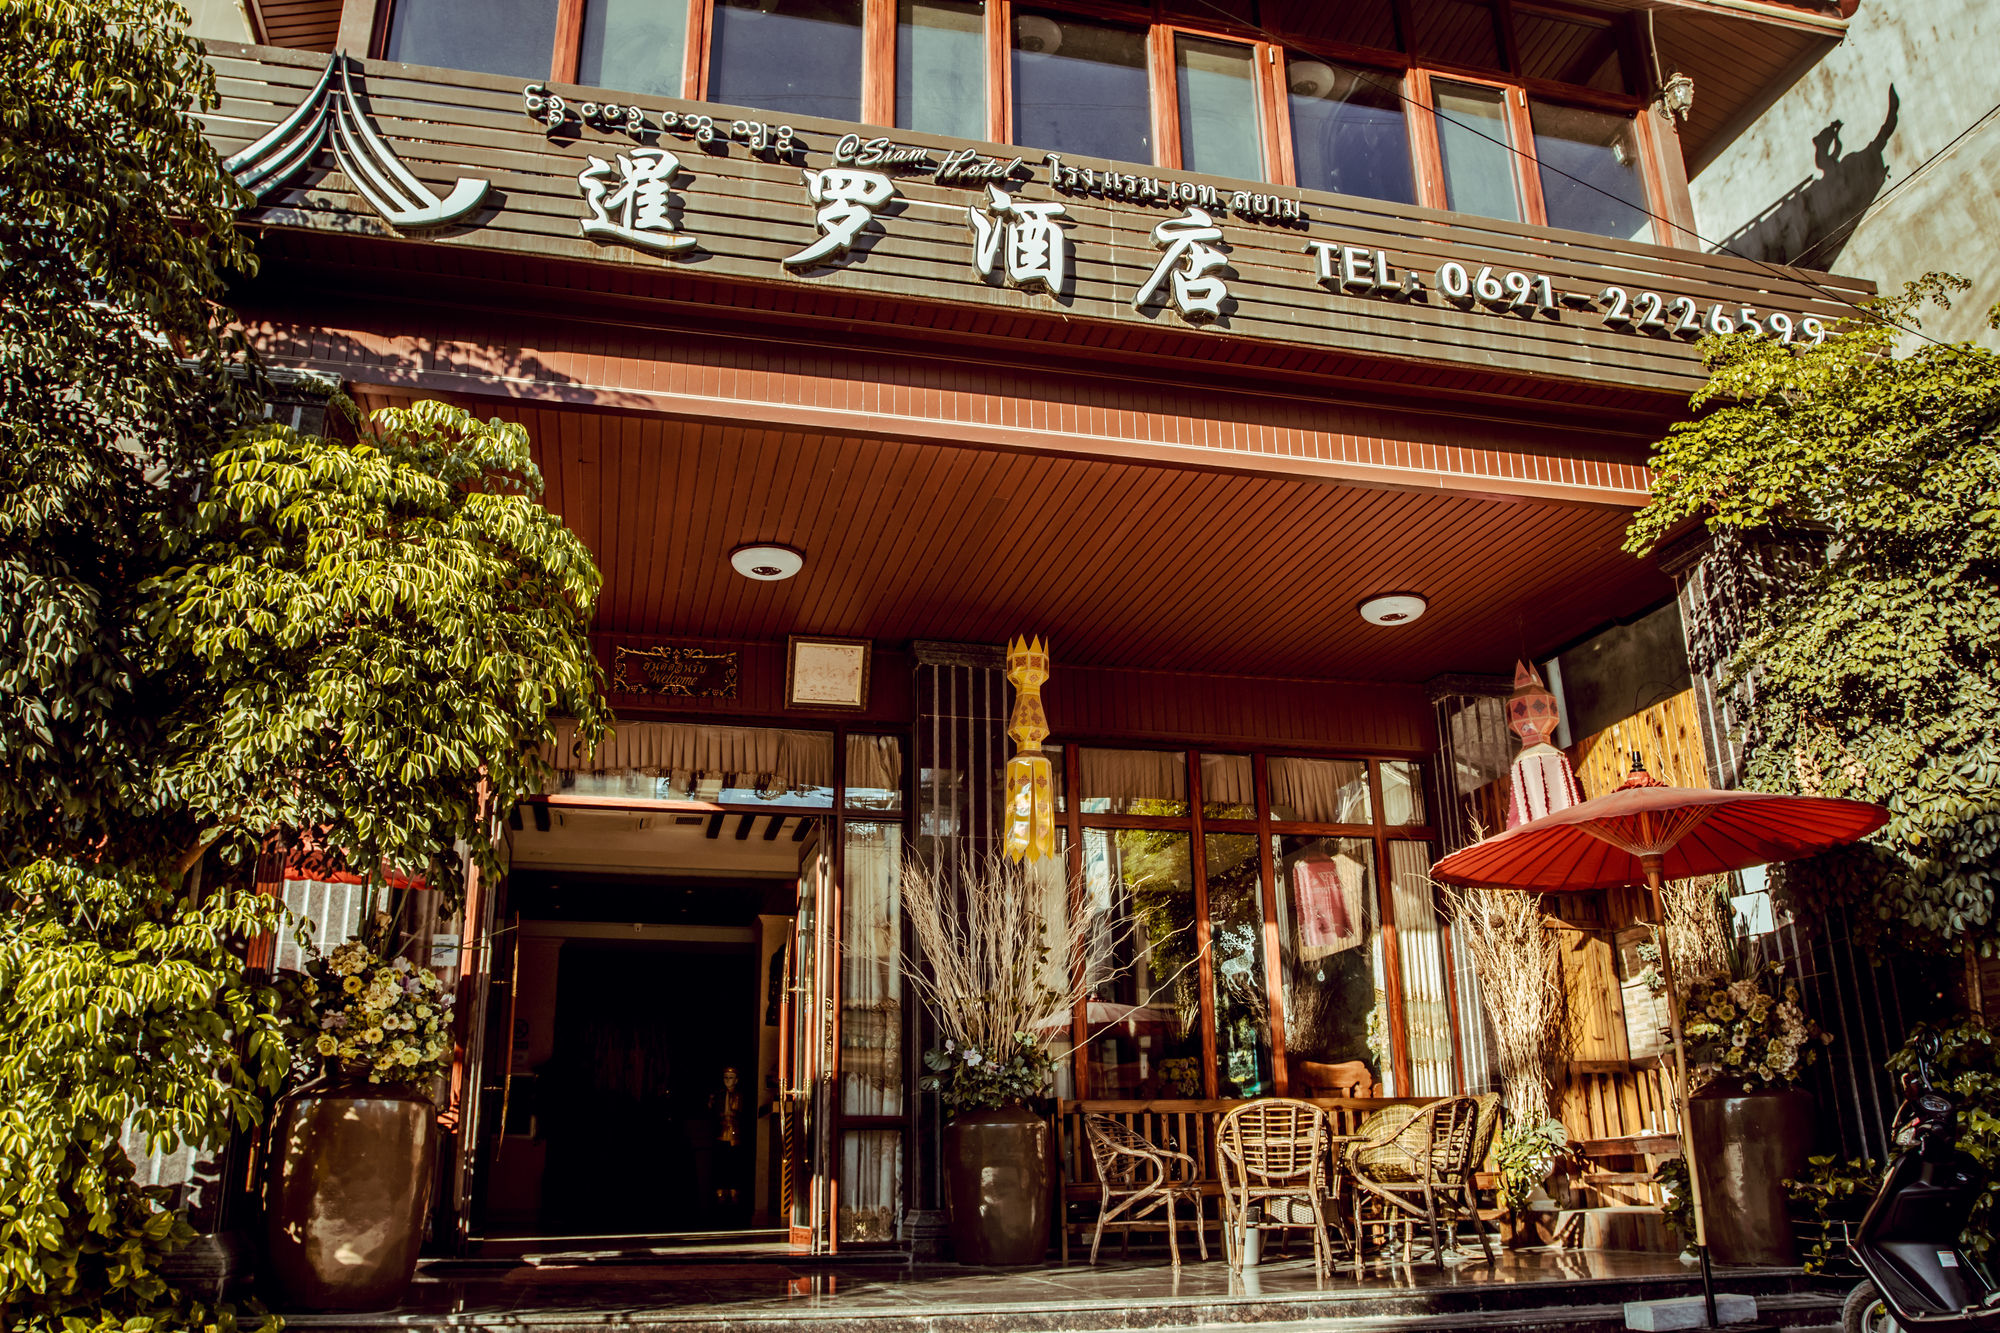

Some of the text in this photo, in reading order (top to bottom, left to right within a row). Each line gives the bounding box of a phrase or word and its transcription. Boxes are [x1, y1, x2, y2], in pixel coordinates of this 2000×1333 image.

[835, 134, 1023, 178] @Siam Hotel
[581, 148, 1229, 314] 暹罗酒店
[649, 670, 699, 686] Welcome
